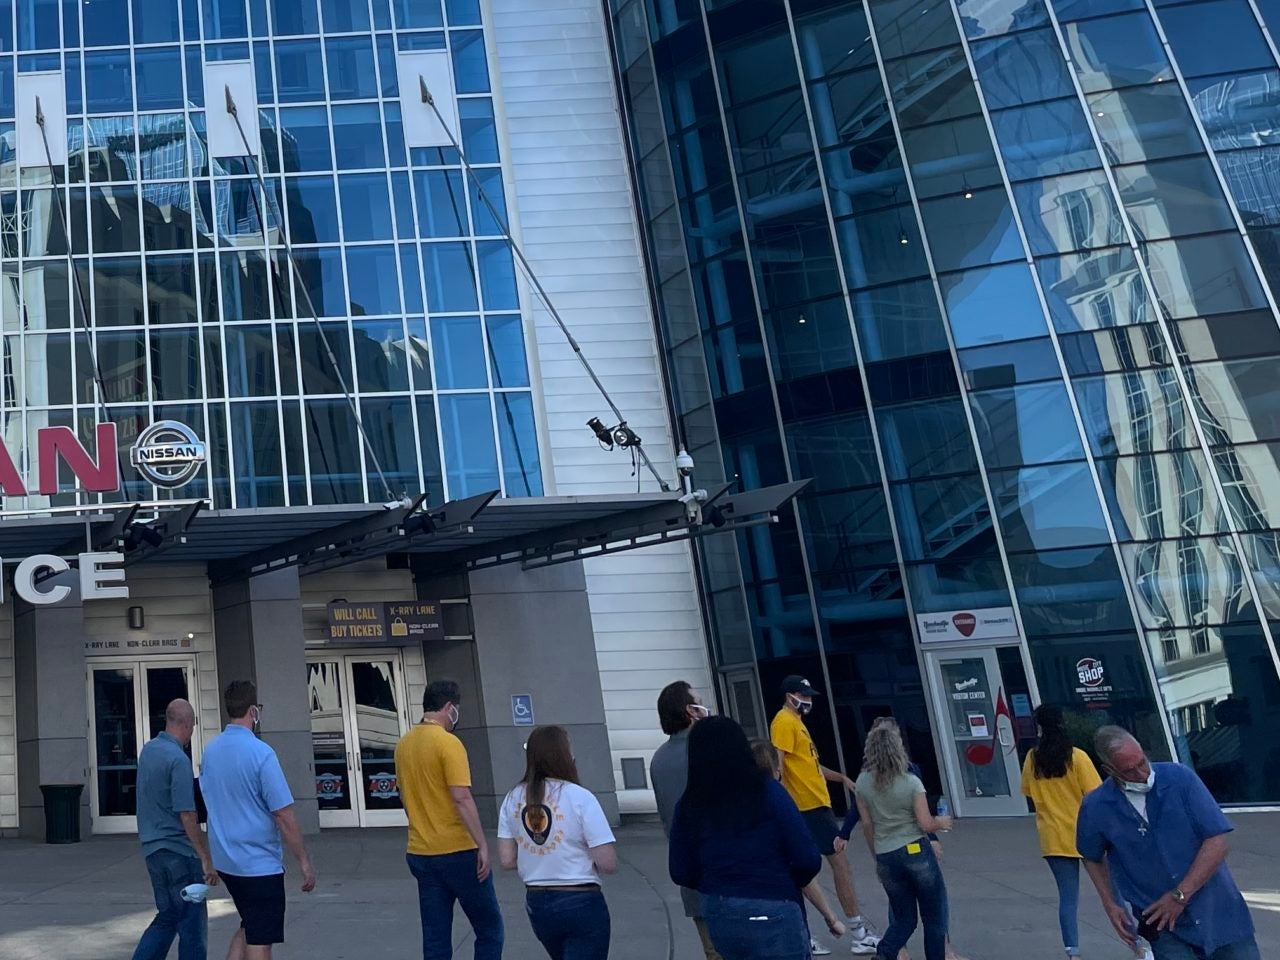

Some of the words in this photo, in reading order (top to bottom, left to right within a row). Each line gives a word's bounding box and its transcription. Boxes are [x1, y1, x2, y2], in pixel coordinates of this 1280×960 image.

[139, 447, 197, 459] NISSAN
[334, 608, 354, 620] WILL
[356, 607, 377, 620] CALL
[390, 606, 413, 615] X-RAY
[417, 606, 436, 615] LANE
[331, 627, 347, 637] BUY
[349, 625, 383, 637] TICKETS
[1078, 666, 1104, 683] SHOP
